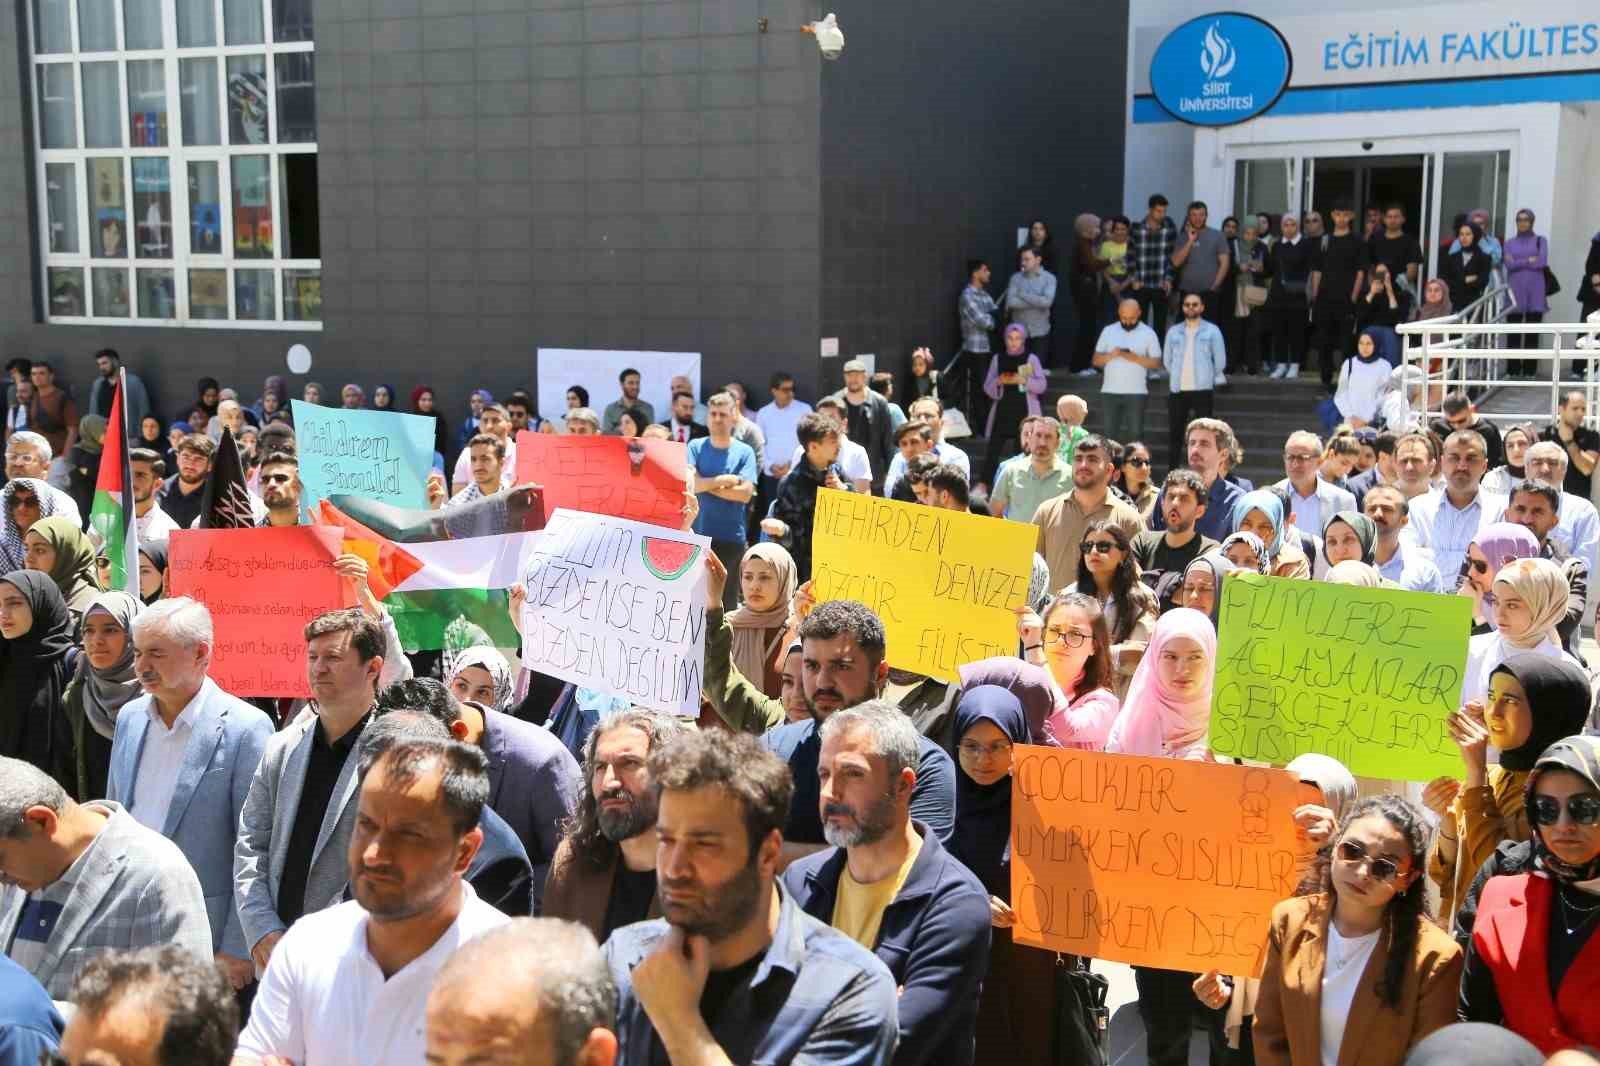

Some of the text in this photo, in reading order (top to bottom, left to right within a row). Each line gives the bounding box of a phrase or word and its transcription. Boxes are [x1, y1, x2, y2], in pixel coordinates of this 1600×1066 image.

[1324, 21, 1599, 71] EĞİTİM FAKÜLTES
[816, 494, 950, 556] NEHİRDEN
[526, 559, 704, 645] BİZDENSE BEN
[934, 560, 1027, 613] DENİZE
[525, 611, 607, 679] BİZDEN
